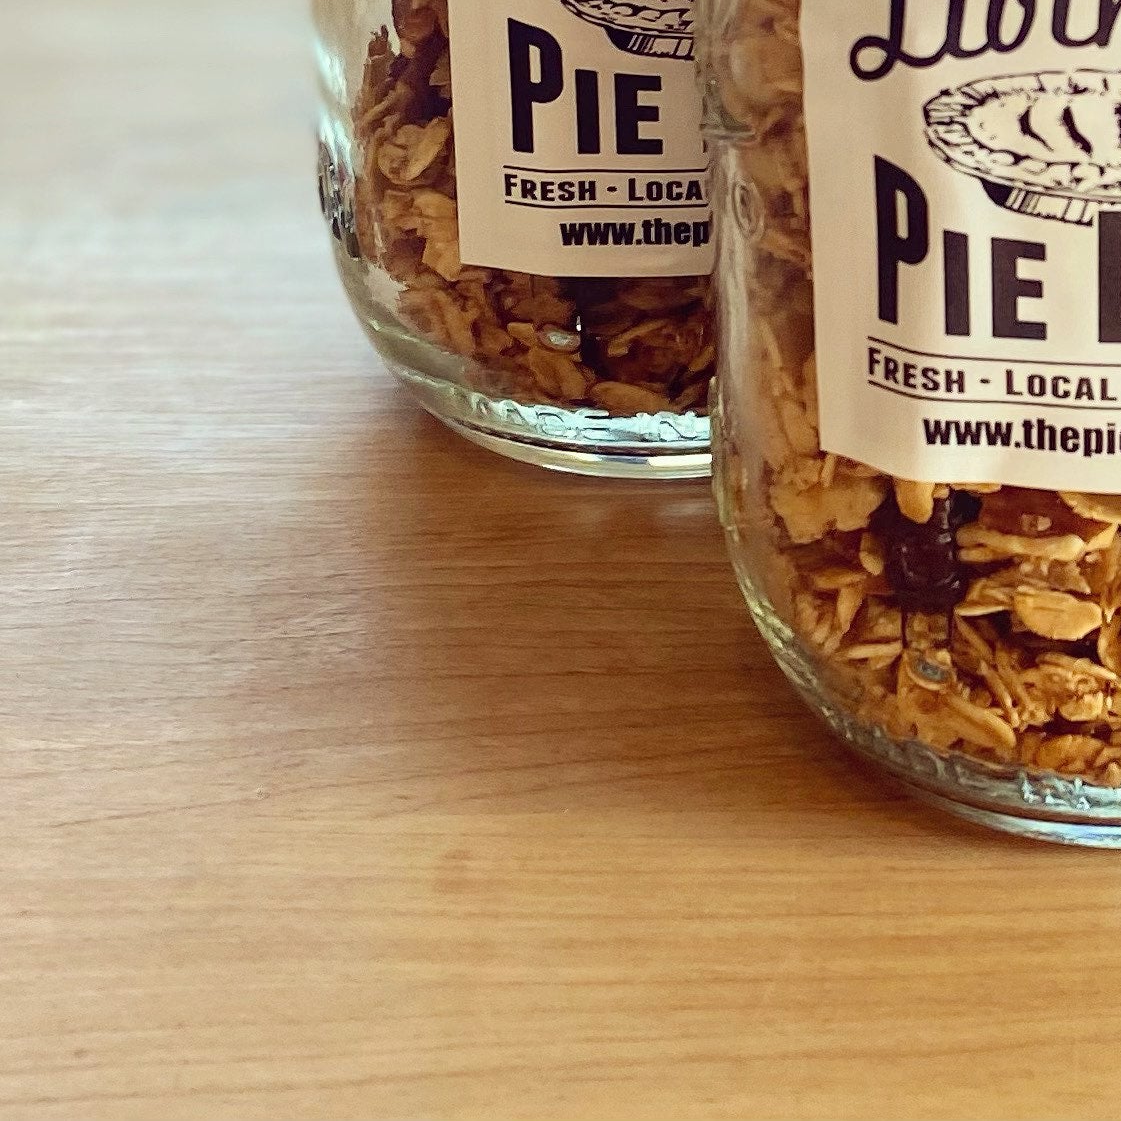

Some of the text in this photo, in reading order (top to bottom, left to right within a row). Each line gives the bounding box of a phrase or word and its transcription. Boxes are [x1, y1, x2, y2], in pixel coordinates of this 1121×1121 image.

[507, 17, 664, 155] PIE
[503, 172, 598, 202] FRESH
[873, 154, 1048, 341] PIE
[867, 345, 966, 395] FRESH
[1004, 368, 1118, 403] LOCAL
